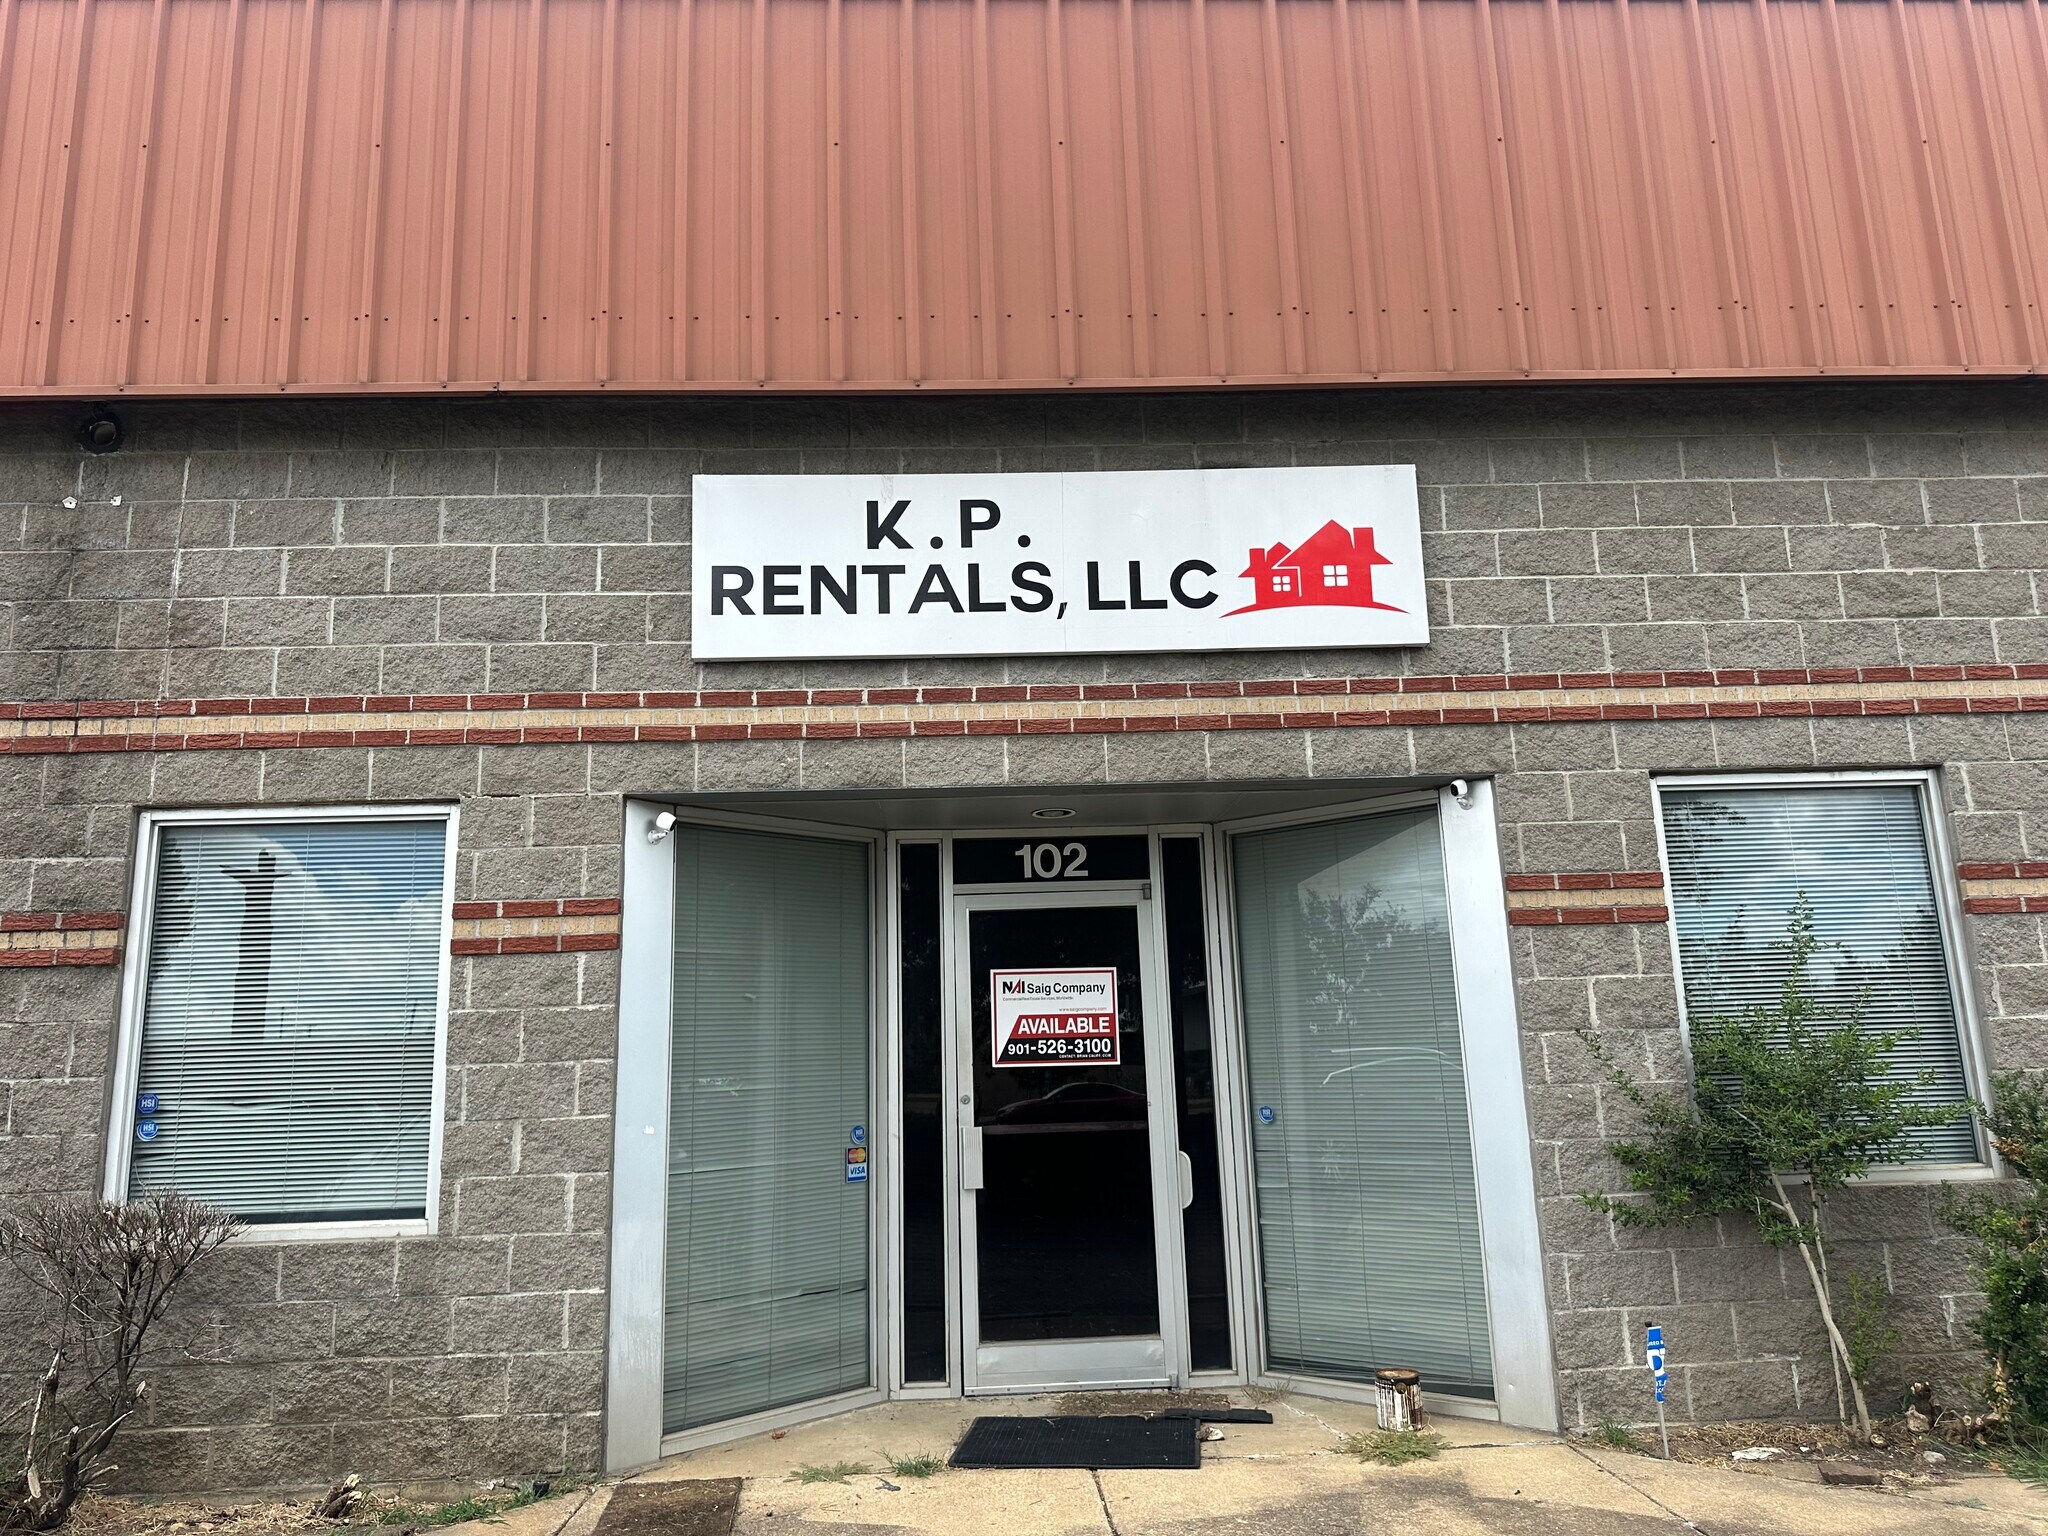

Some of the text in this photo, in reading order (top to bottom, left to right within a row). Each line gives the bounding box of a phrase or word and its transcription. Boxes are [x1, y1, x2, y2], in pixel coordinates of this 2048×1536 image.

[710, 559, 1219, 620] RENTALS, LLC
[1015, 843, 1089, 878] 102
[1002, 978, 1106, 996] NAI Saig Company
[1017, 1016, 1111, 1035] AVAILABLE
[1008, 1038, 1111, 1055] 901-526-3100
[141, 1099, 155, 1107] HSI
[850, 1166, 866, 1175] VISA
